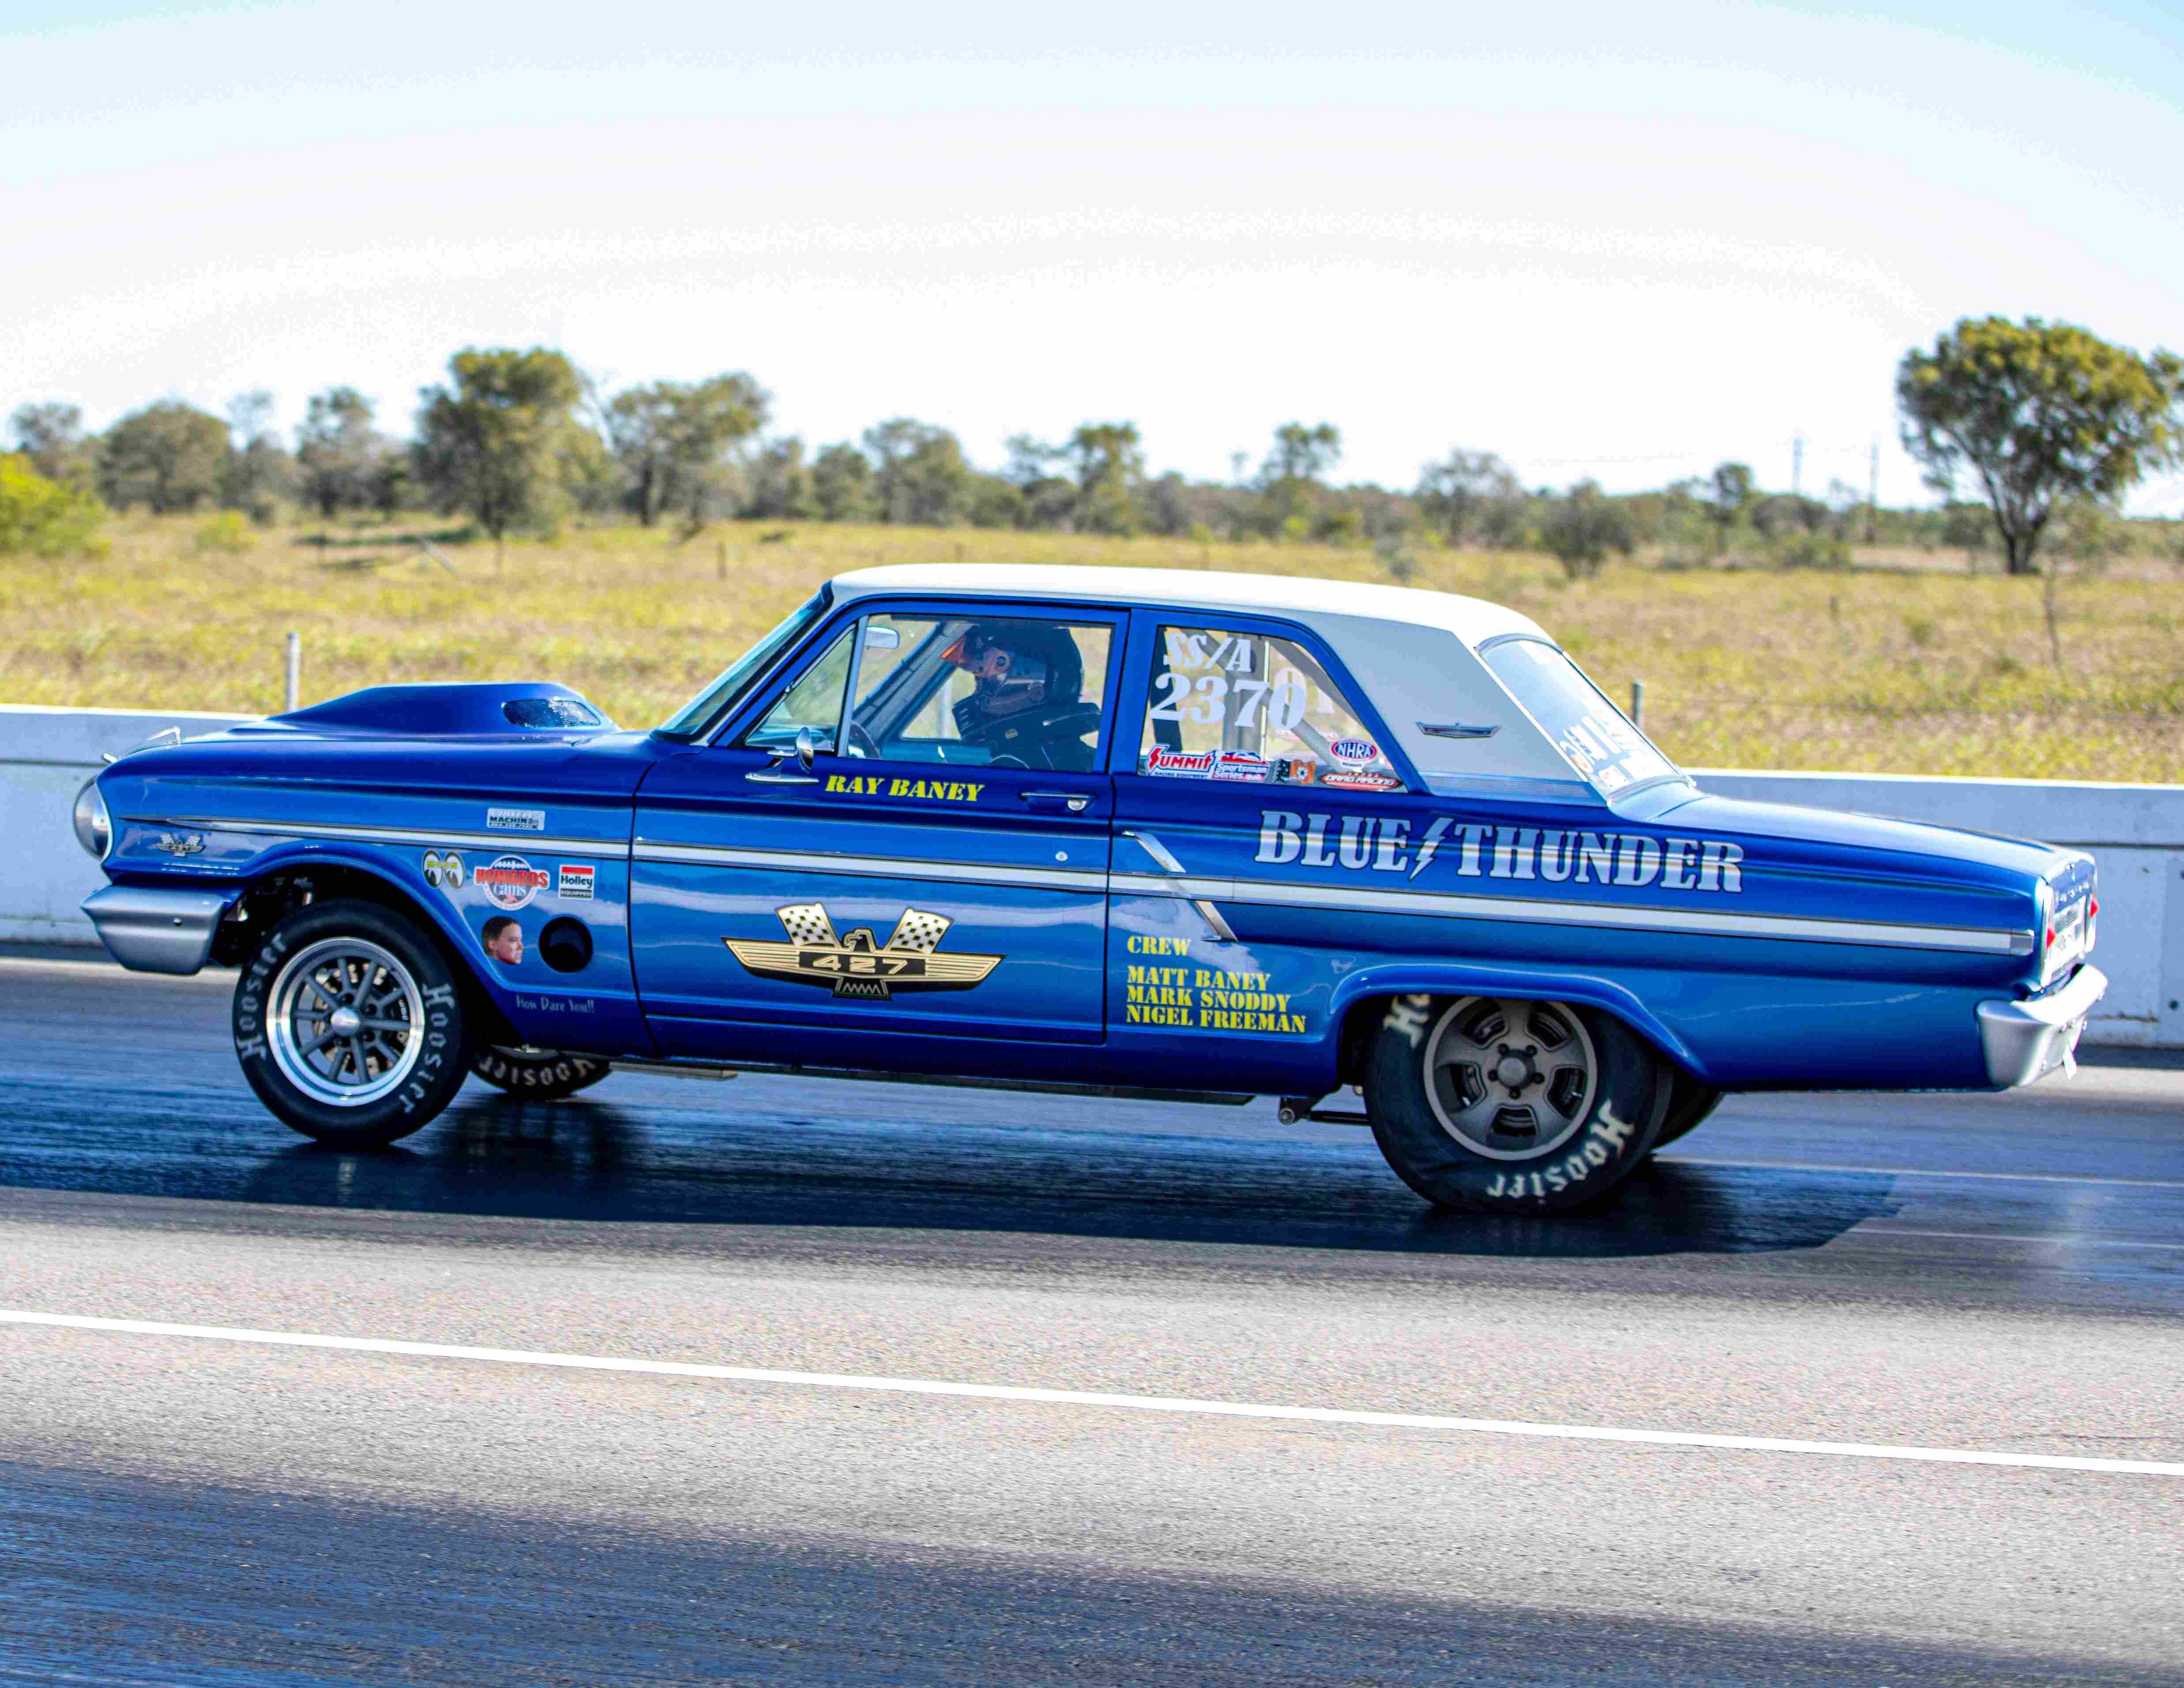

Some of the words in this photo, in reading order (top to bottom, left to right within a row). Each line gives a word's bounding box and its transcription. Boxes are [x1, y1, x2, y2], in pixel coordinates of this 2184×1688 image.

[1163, 633, 1252, 672] SS/A
[1149, 673, 1307, 731] 2370
[1338, 742, 1371, 758] NHRA
[1214, 771, 1243, 779] Series
[1217, 763, 1267, 774] Sportsman
[825, 775, 885, 794] RAY
[887, 778, 986, 802] BANEY
[1254, 810, 1412, 871] BLUE
[1455, 824, 1744, 892] THUNDER
[476, 868, 548, 888] HOWARDS
[561, 875, 593, 889] Holley
[1127, 936, 1191, 956] CREW
[812, 955, 908, 975] 427
[1127, 965, 1189, 987] MATT
[1195, 969, 1271, 991] BANEY
[541, 996, 565, 1011] Dare
[1127, 986, 1193, 1007] MARK
[1200, 990, 1291, 1013] SNODDY
[1126, 1005, 1193, 1026] NIGEL
[1200, 1010, 1306, 1033] FREEMAN
